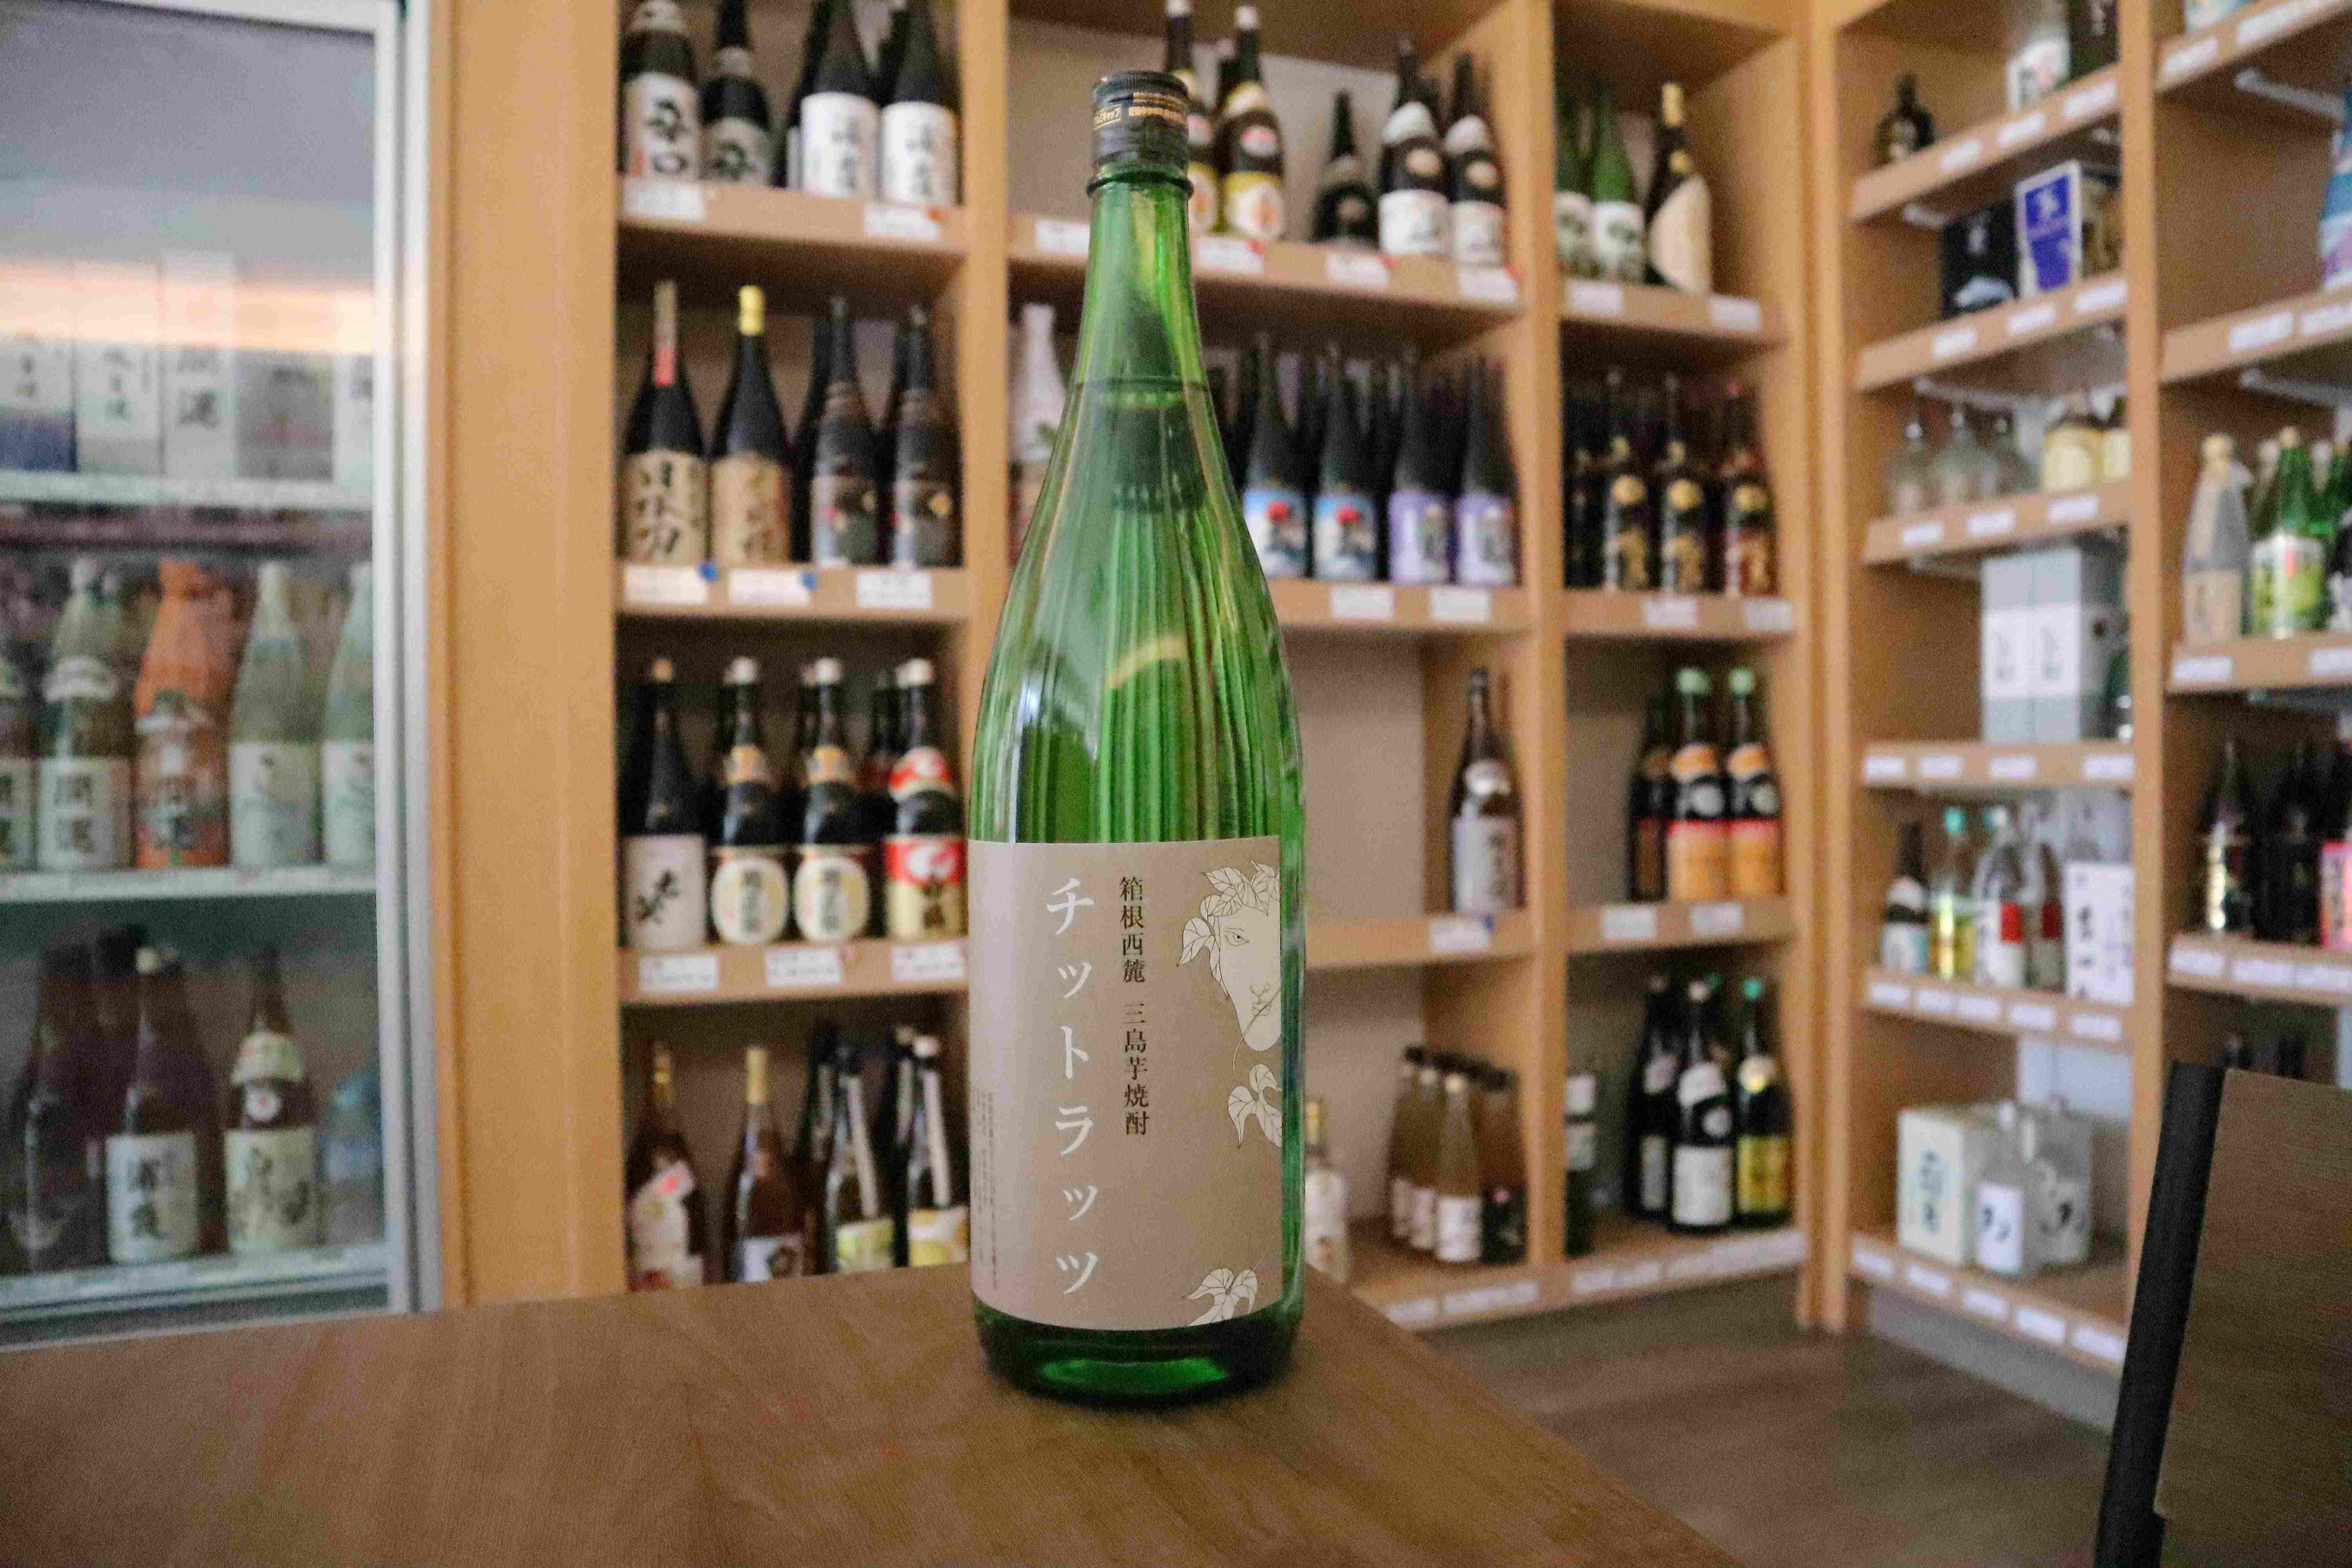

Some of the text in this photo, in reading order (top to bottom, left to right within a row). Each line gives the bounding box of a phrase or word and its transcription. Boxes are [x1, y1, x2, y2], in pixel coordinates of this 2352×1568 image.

[1047, 878, 1098, 1295] チットラッツ
[1119, 876, 1149, 1135] 箱根西麓 三島芋焼酎
